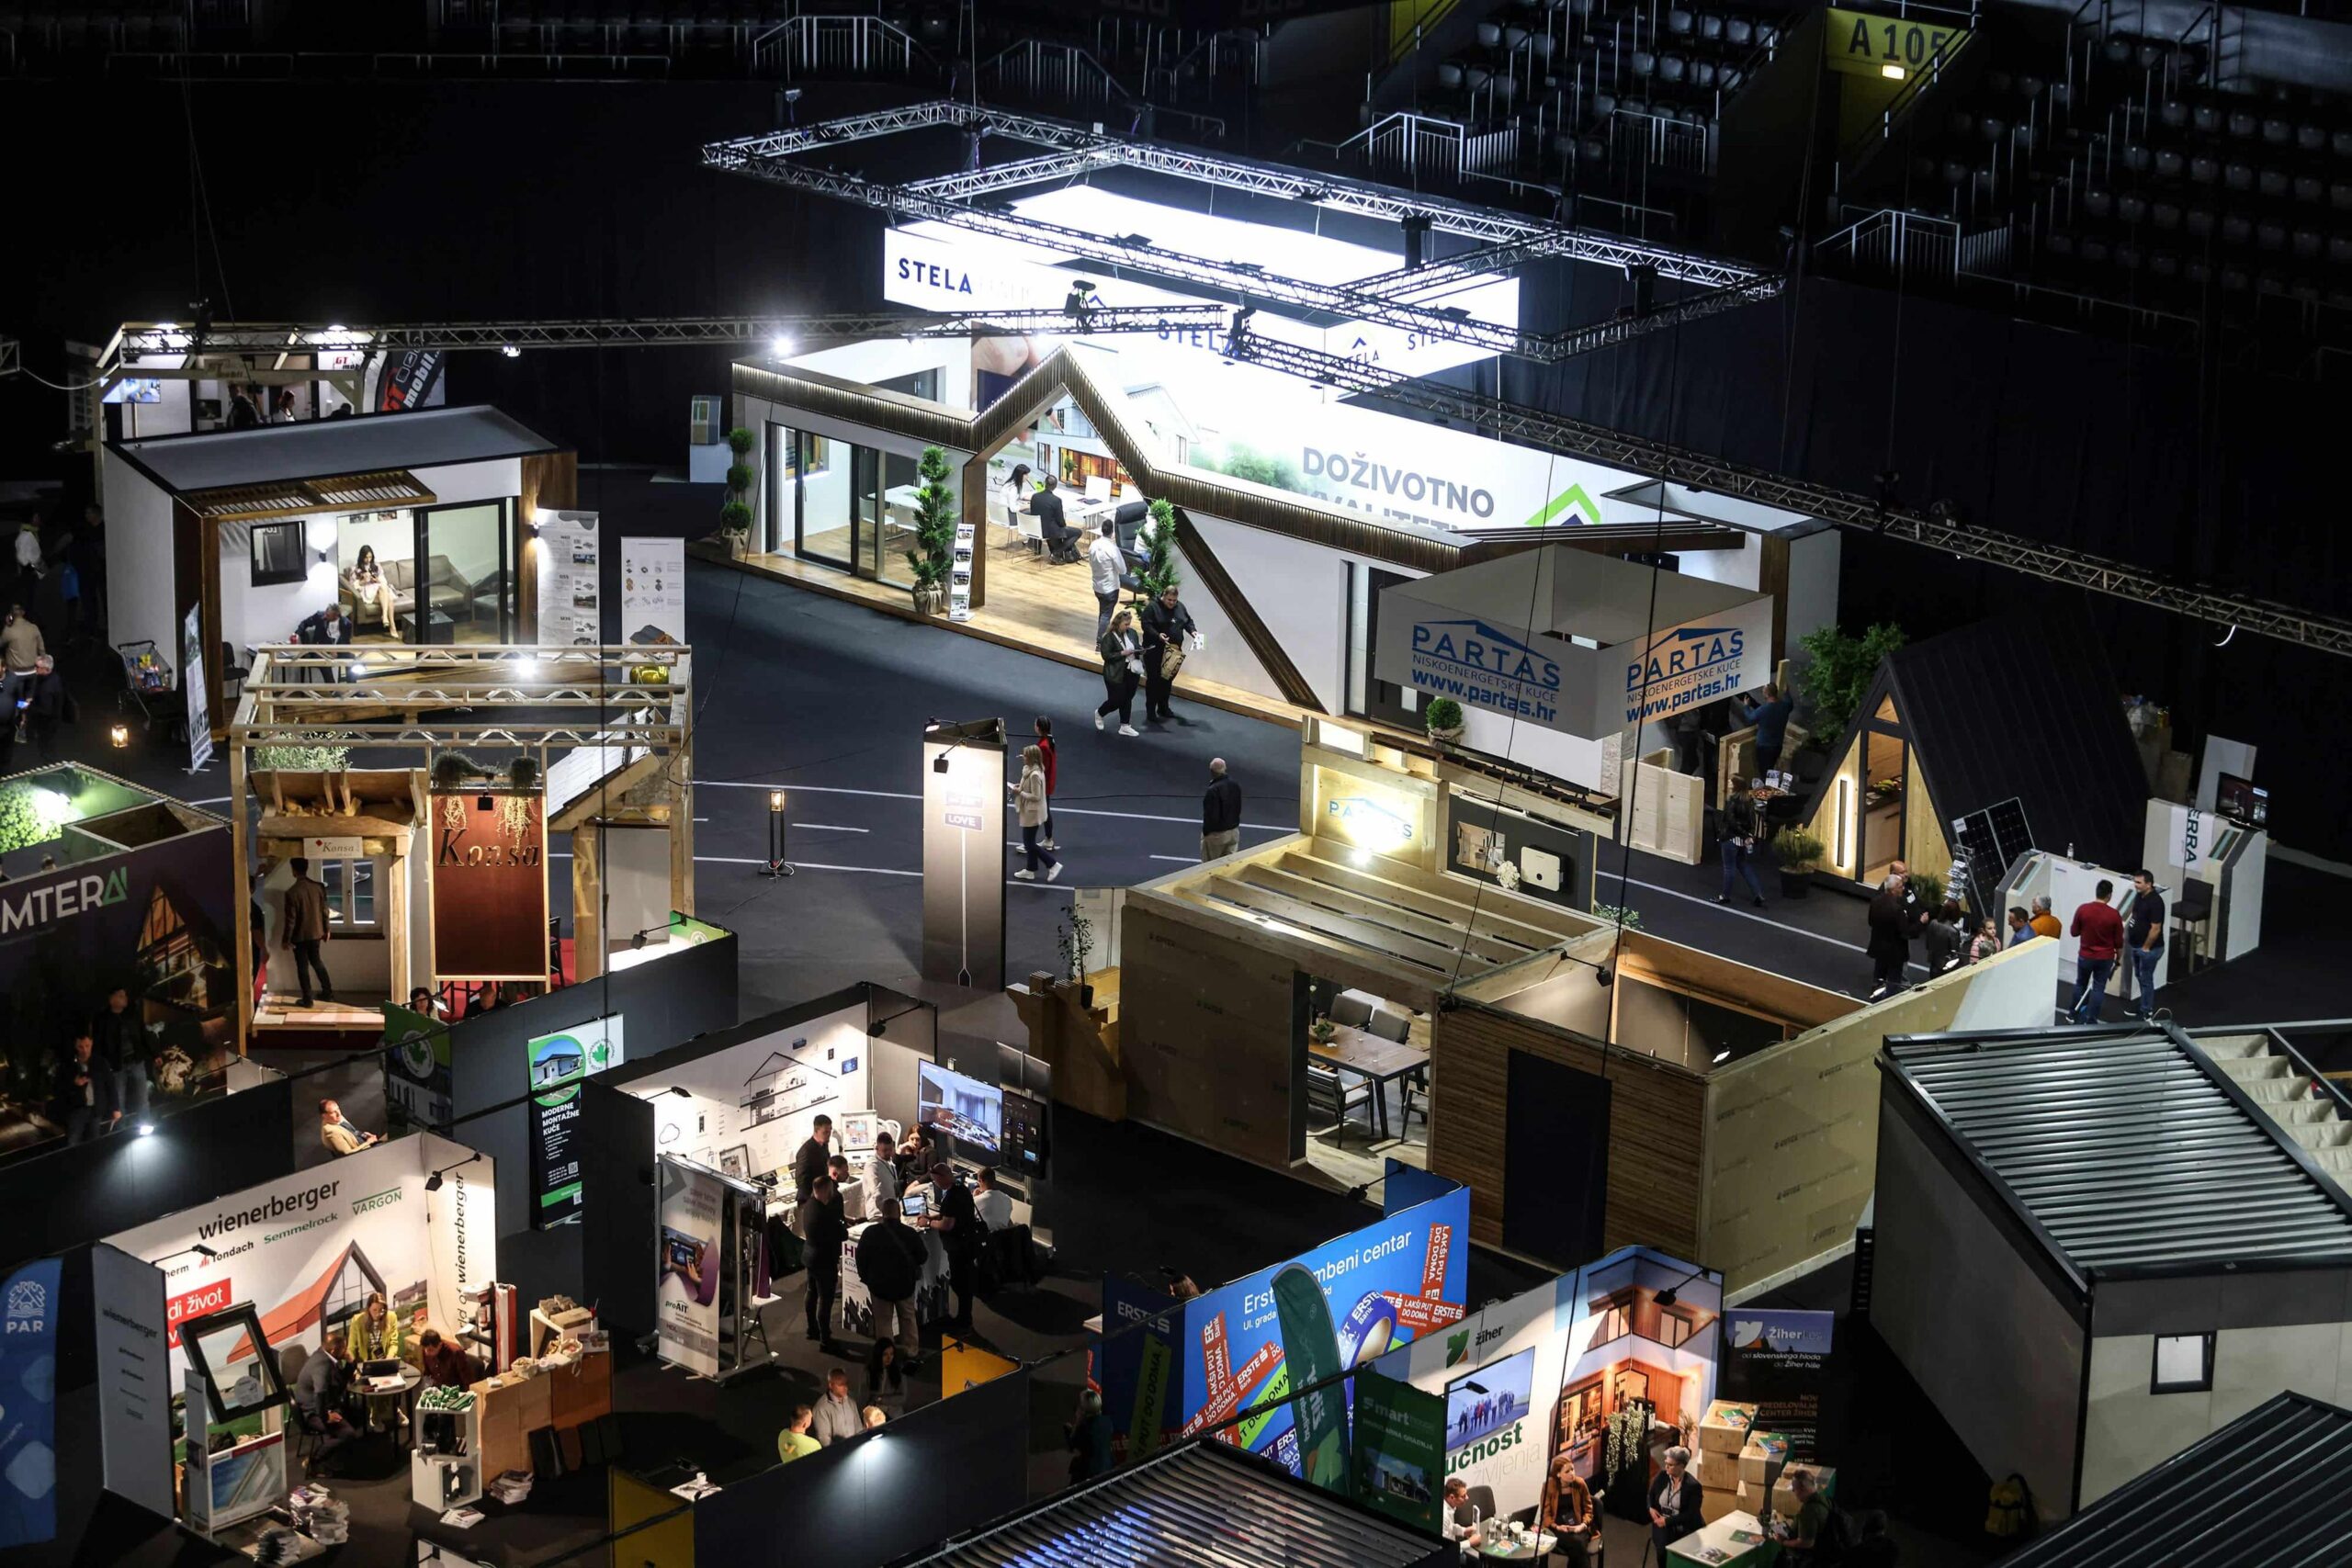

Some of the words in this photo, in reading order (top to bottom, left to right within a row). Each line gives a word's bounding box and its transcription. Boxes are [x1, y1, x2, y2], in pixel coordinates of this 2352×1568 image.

[1849, 18, 1871, 57] A
[898, 257, 973, 295] STELA
[1303, 446, 1495, 518] DOŽIVOTNO
[1412, 624, 1560, 688] PARTAS
[1627, 630, 1744, 688] PARTAS
[1412, 654, 1521, 692] NISKOENERGETSKE
[1627, 667, 1714, 704] NISKOENERGETSKE
[1412, 669, 1557, 722] www.partas.hr
[1626, 674, 1741, 723] www.partas.hr
[948, 814, 977, 827] LOVE
[322, 841, 355, 852] Konsa
[436, 828, 540, 867] Konsa
[541, 1101, 574, 1119] MODERNE
[542, 1109, 580, 1128] MONTAŽNE
[198, 1179, 340, 1241] wienerberger
[352, 1190, 402, 1216] VARGON
[264, 1213, 339, 1245] Semmelrock
[455, 1171, 468, 1283] wienerberger
[1433, 1226, 1442, 1244] DO
[1363, 1231, 1412, 1264] centar
[1439, 1225, 1450, 1258] LAKŠI
[1435, 1259, 1444, 1282] PUT
[187, 1287, 223, 1314] život
[1351, 1292, 1379, 1321] ERSTE
[1401, 1308, 1411, 1317] DO
[1404, 1299, 1422, 1310] LAKŠI
[1421, 1303, 1433, 1311] PUT
[1433, 1304, 1455, 1319] ERSTE
[6, 1319, 44, 1334] PAR
[102, 1307, 159, 1338] wienerberger
[1243, 1320, 1254, 1331] Ul.
[1255, 1311, 1277, 1327] grada
[1358, 1305, 1374, 1325] Bank
[1475, 1325, 1504, 1347] žiher
[1206, 1349, 1216, 1371] PUT
[1237, 1356, 1261, 1384] ERSTE
[1752, 1353, 1798, 1361] slovenskega
[1204, 1393, 1223, 1416] LAKŠI
[1222, 1381, 1236, 1396] PUT
[1206, 1411, 1216, 1423] DO
